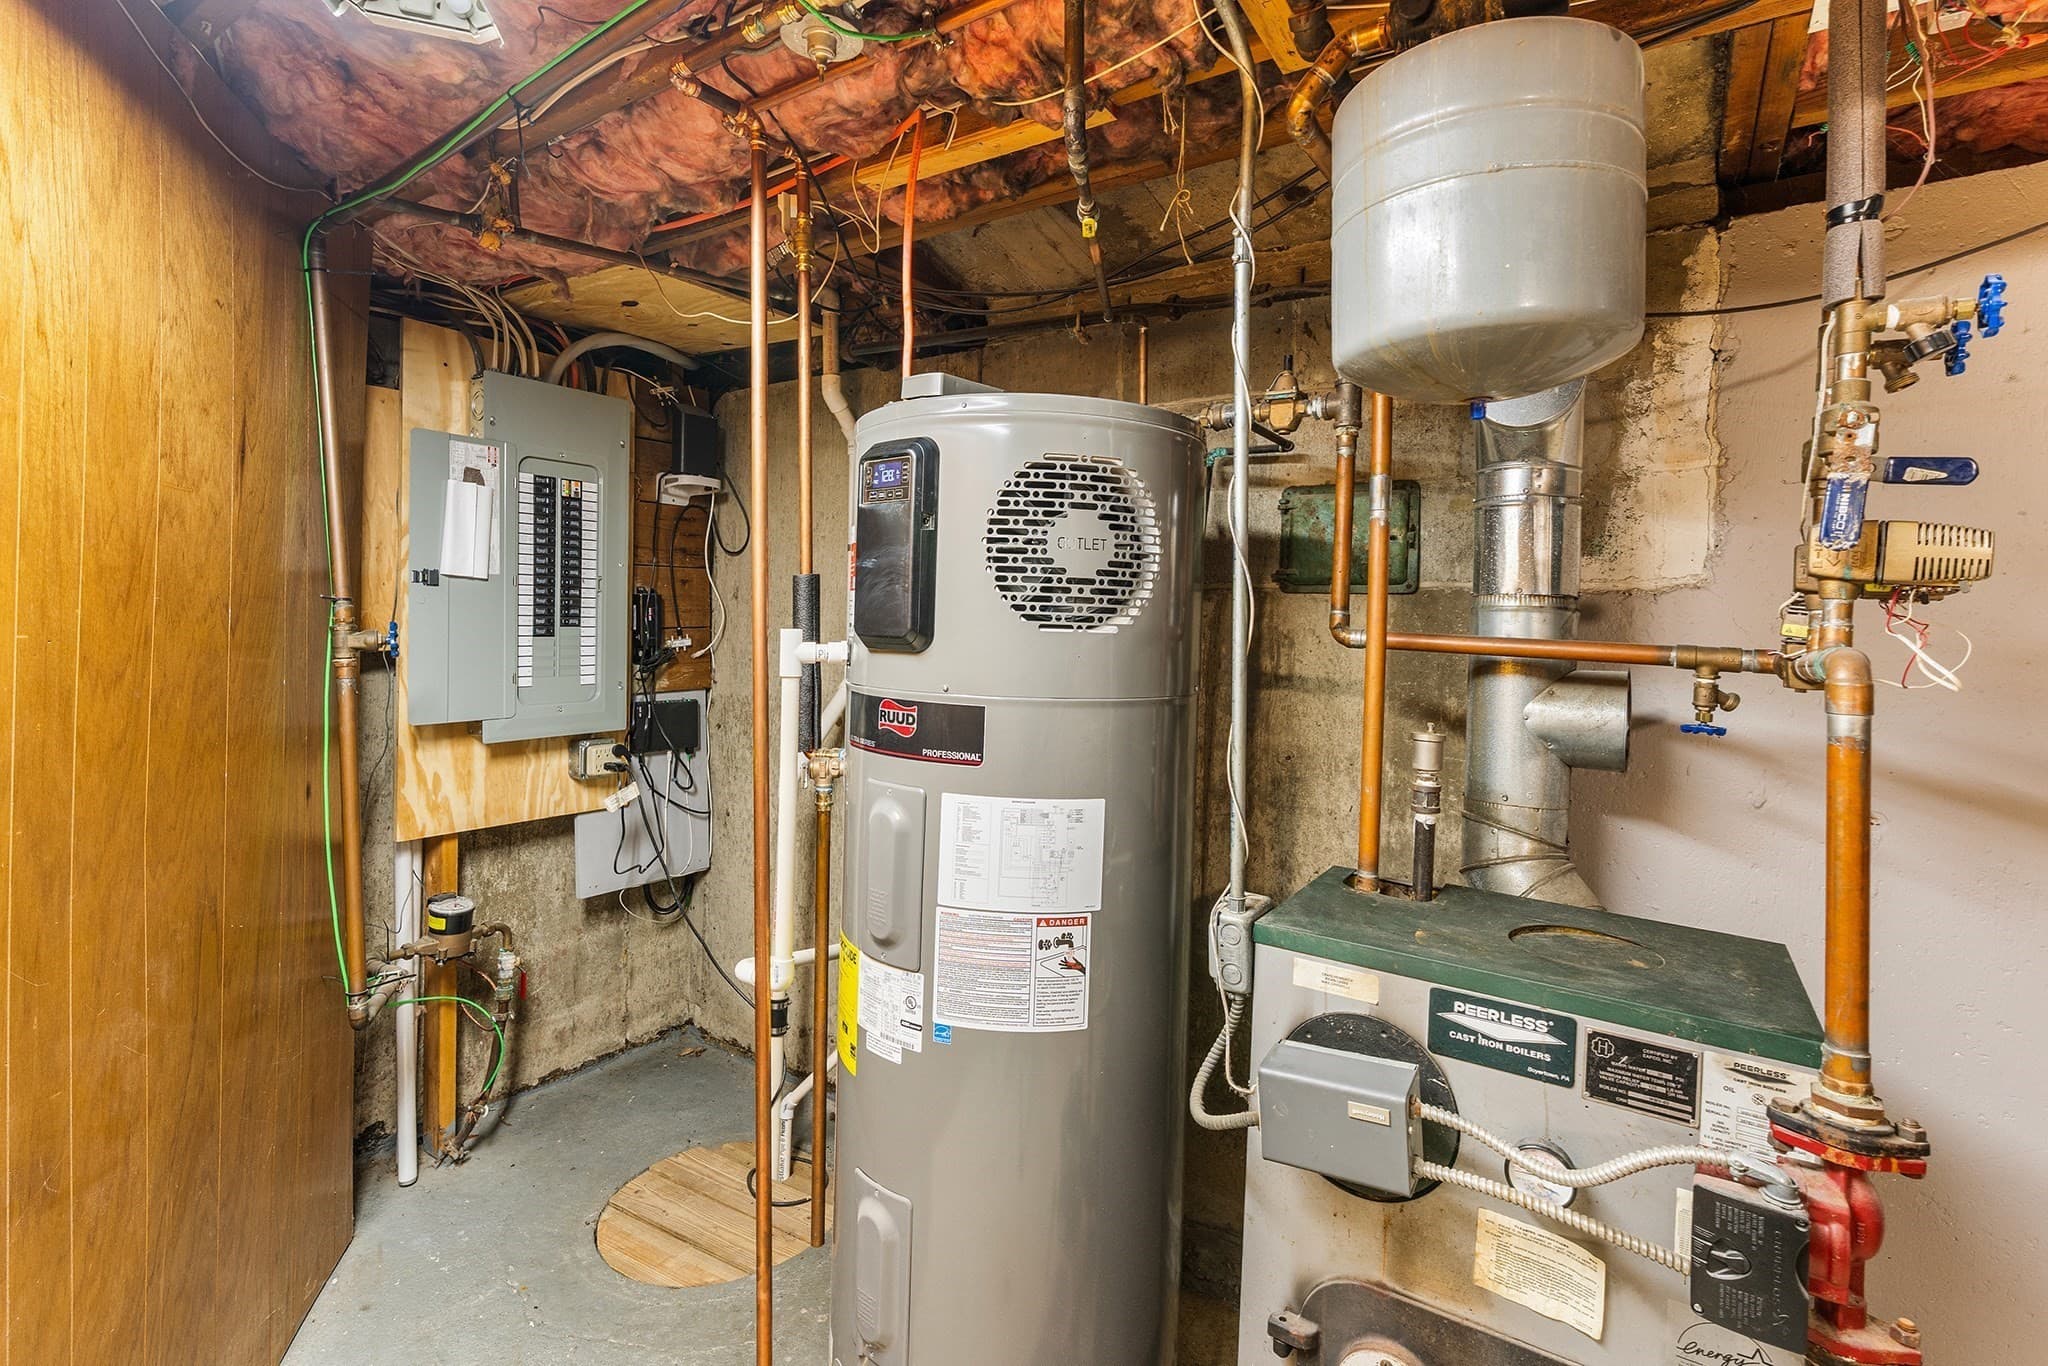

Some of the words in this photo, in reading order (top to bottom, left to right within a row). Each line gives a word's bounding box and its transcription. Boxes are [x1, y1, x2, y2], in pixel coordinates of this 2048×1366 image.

[1057, 536, 1107, 551] OTLET
[879, 709, 916, 726] RUUD
[922, 748, 982, 761] PROFESSIONAL
[1049, 918, 1085, 926] DANGER
[1453, 1001, 1549, 1033] PEERLESS
[1449, 1030, 1476, 1043] CAST
[1478, 1033, 1504, 1051] IRON
[1505, 1044, 1552, 1062] BOILERS
[1597, 1039, 1608, 1055] H
[1560, 1074, 1571, 1082] PA
[1733, 1062, 1787, 1080] PEERLESS
[1676, 1341, 1746, 1366] energy
